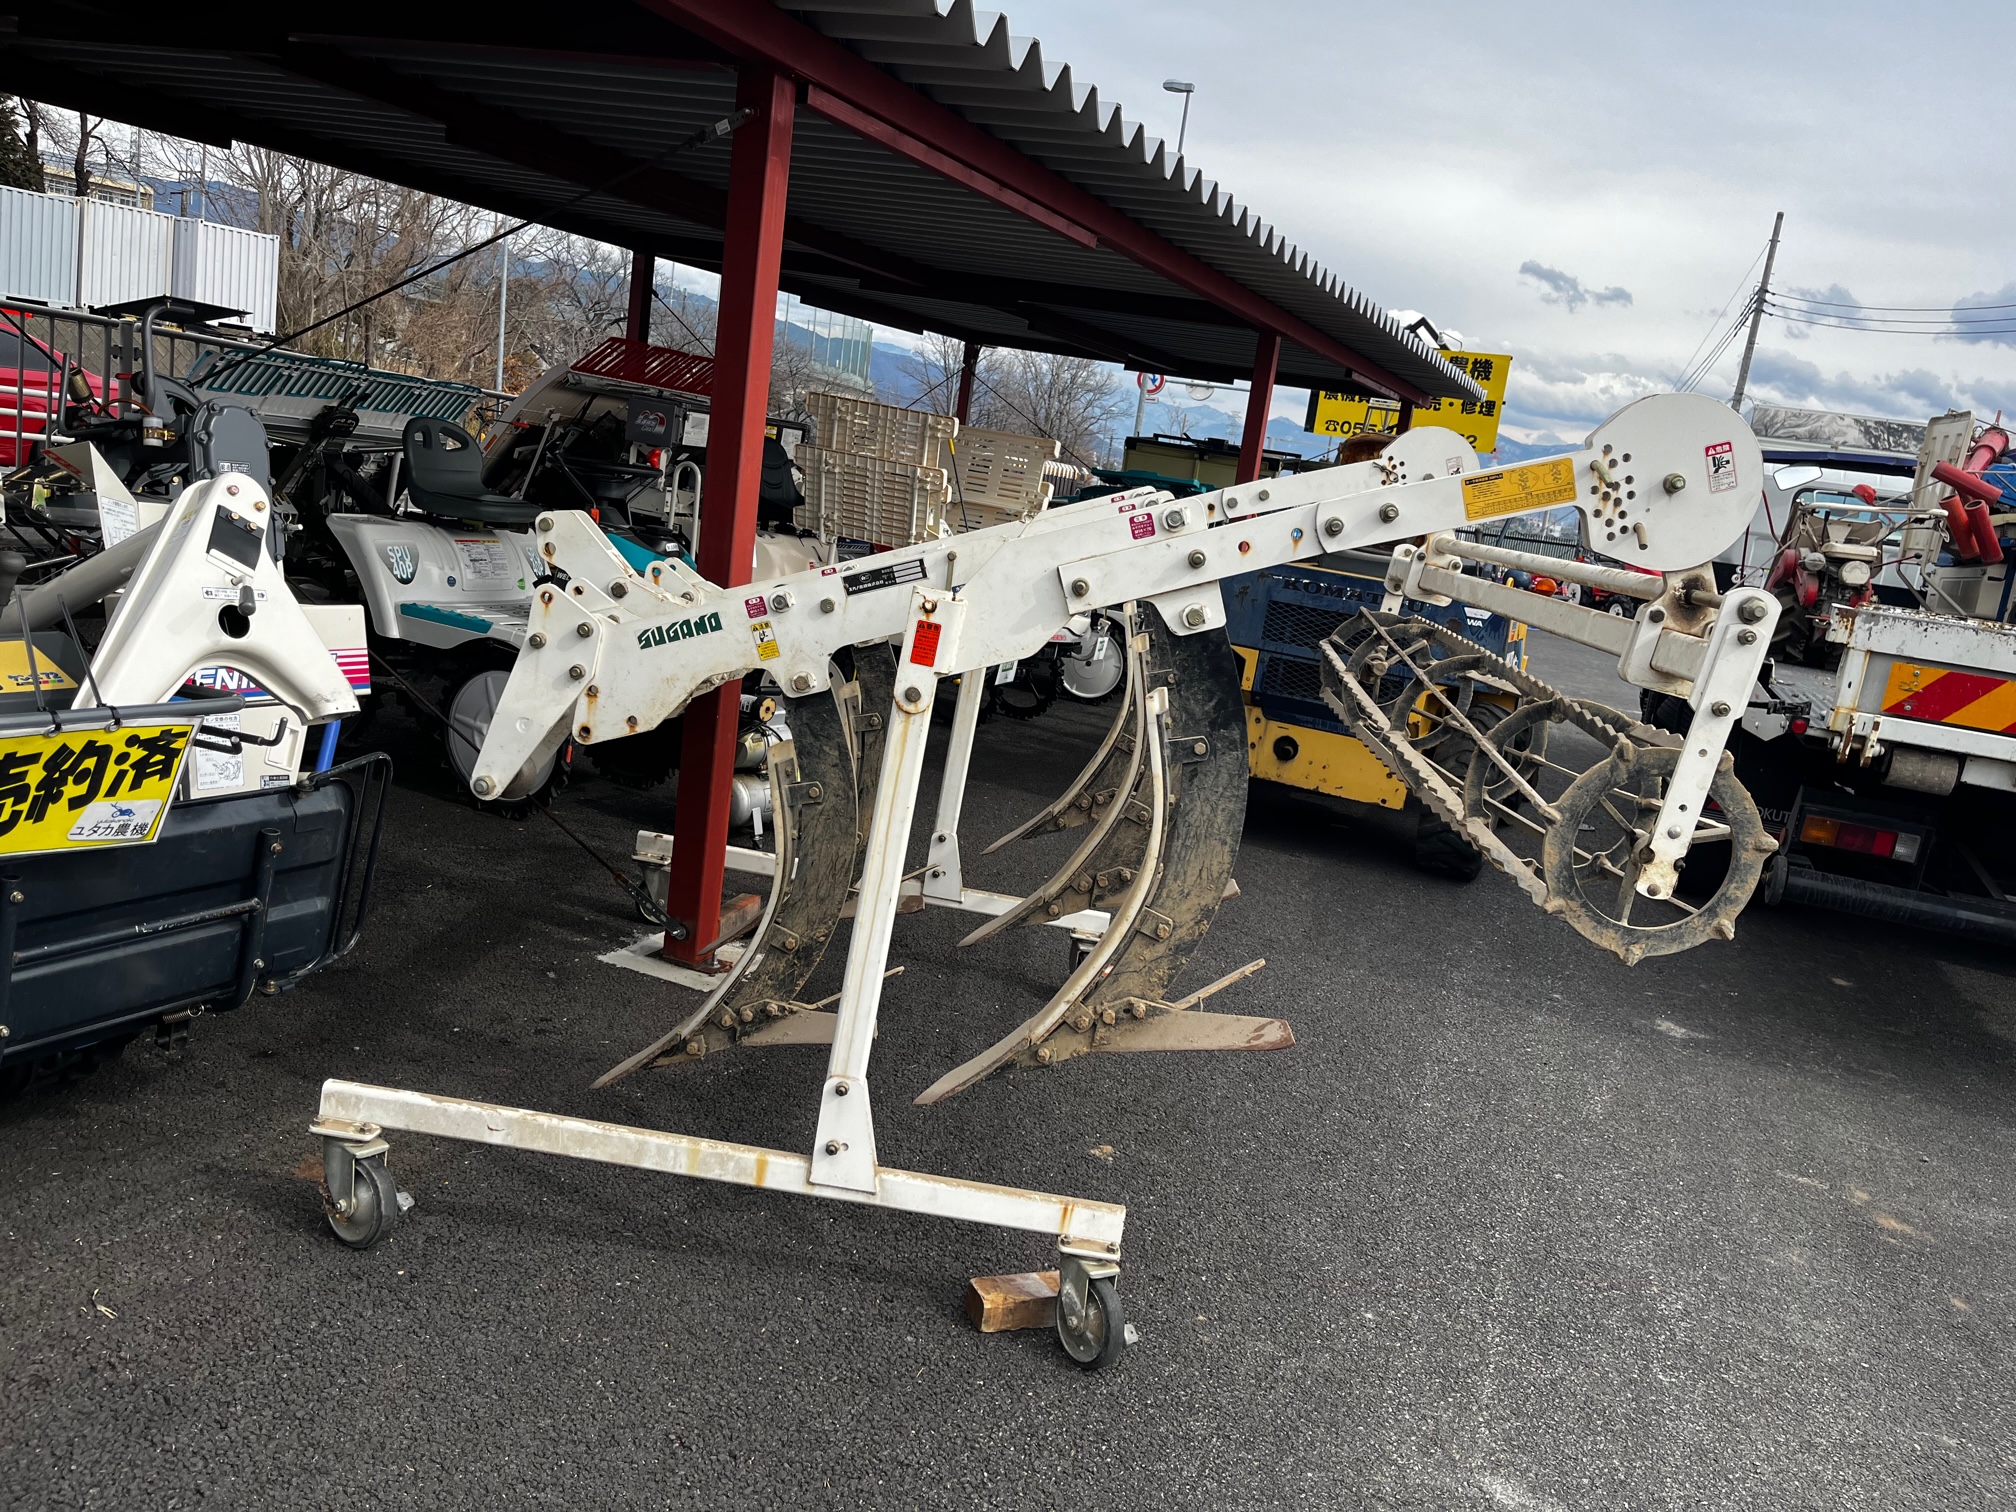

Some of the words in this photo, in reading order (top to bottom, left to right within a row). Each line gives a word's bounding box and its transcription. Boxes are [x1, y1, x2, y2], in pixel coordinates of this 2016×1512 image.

[387, 545, 411, 562] SPU
[393, 560, 413, 579] 40P
[1282, 578, 1426, 613] KOMATU
[637, 612, 723, 650] SUGANO
[1466, 618, 1483, 628] WA
[0, 729, 189, 837] 売約済
[70, 822, 149, 837] ユタカ農機
